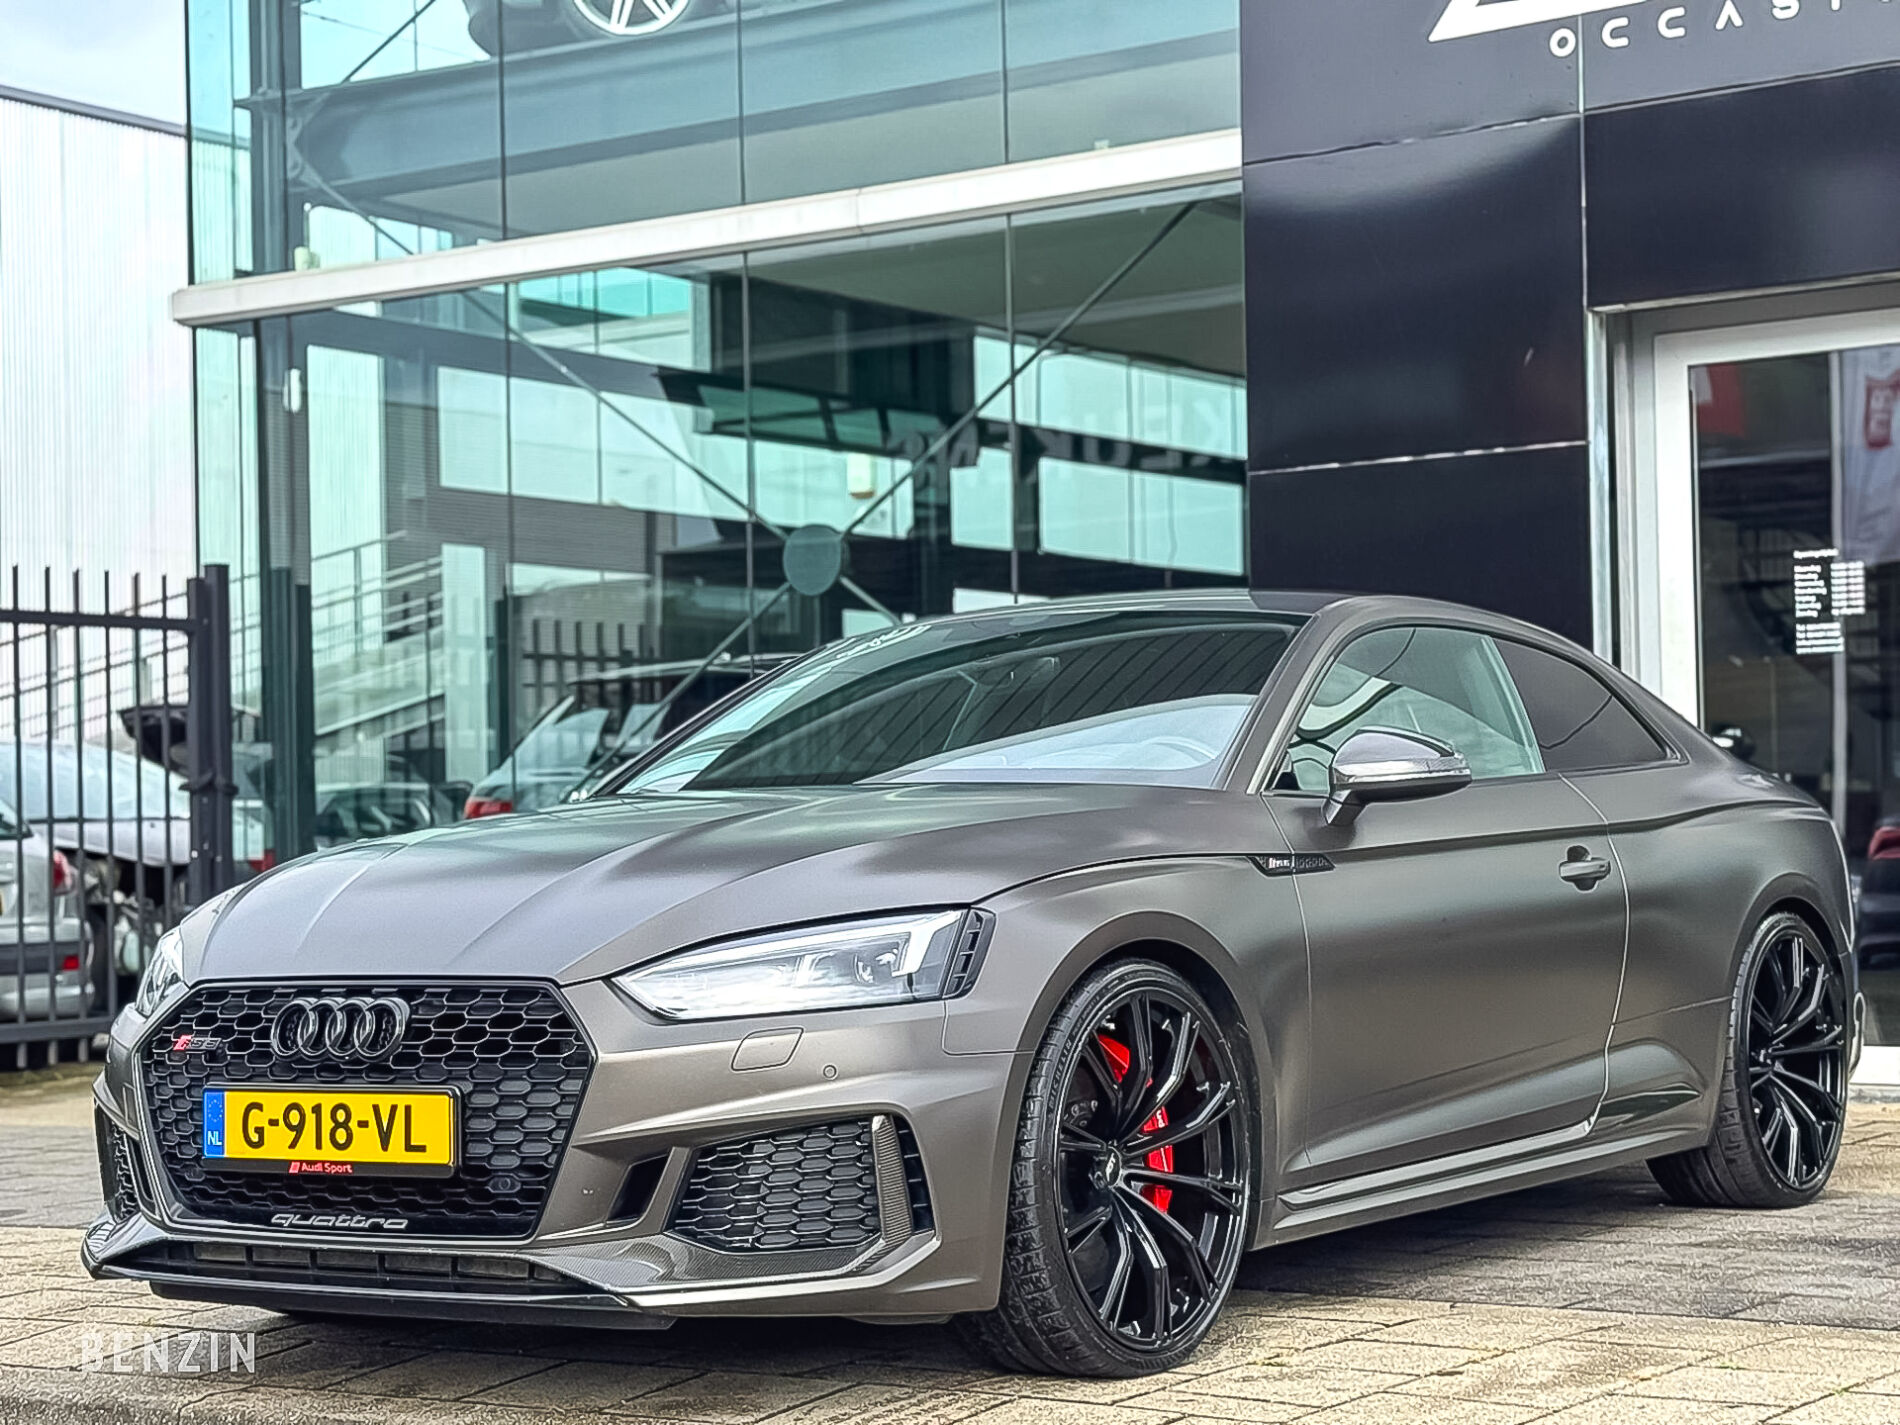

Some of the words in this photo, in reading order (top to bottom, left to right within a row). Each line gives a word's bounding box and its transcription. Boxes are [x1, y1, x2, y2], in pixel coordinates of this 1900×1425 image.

[1549, 0, 1893, 57] OCCAS
[242, 1102, 427, 1153] G-918-VL
[207, 1131, 222, 1146] NL
[301, 1162, 323, 1172] Audi
[324, 1162, 353, 1174] Sport
[271, 1213, 408, 1229] quattro
